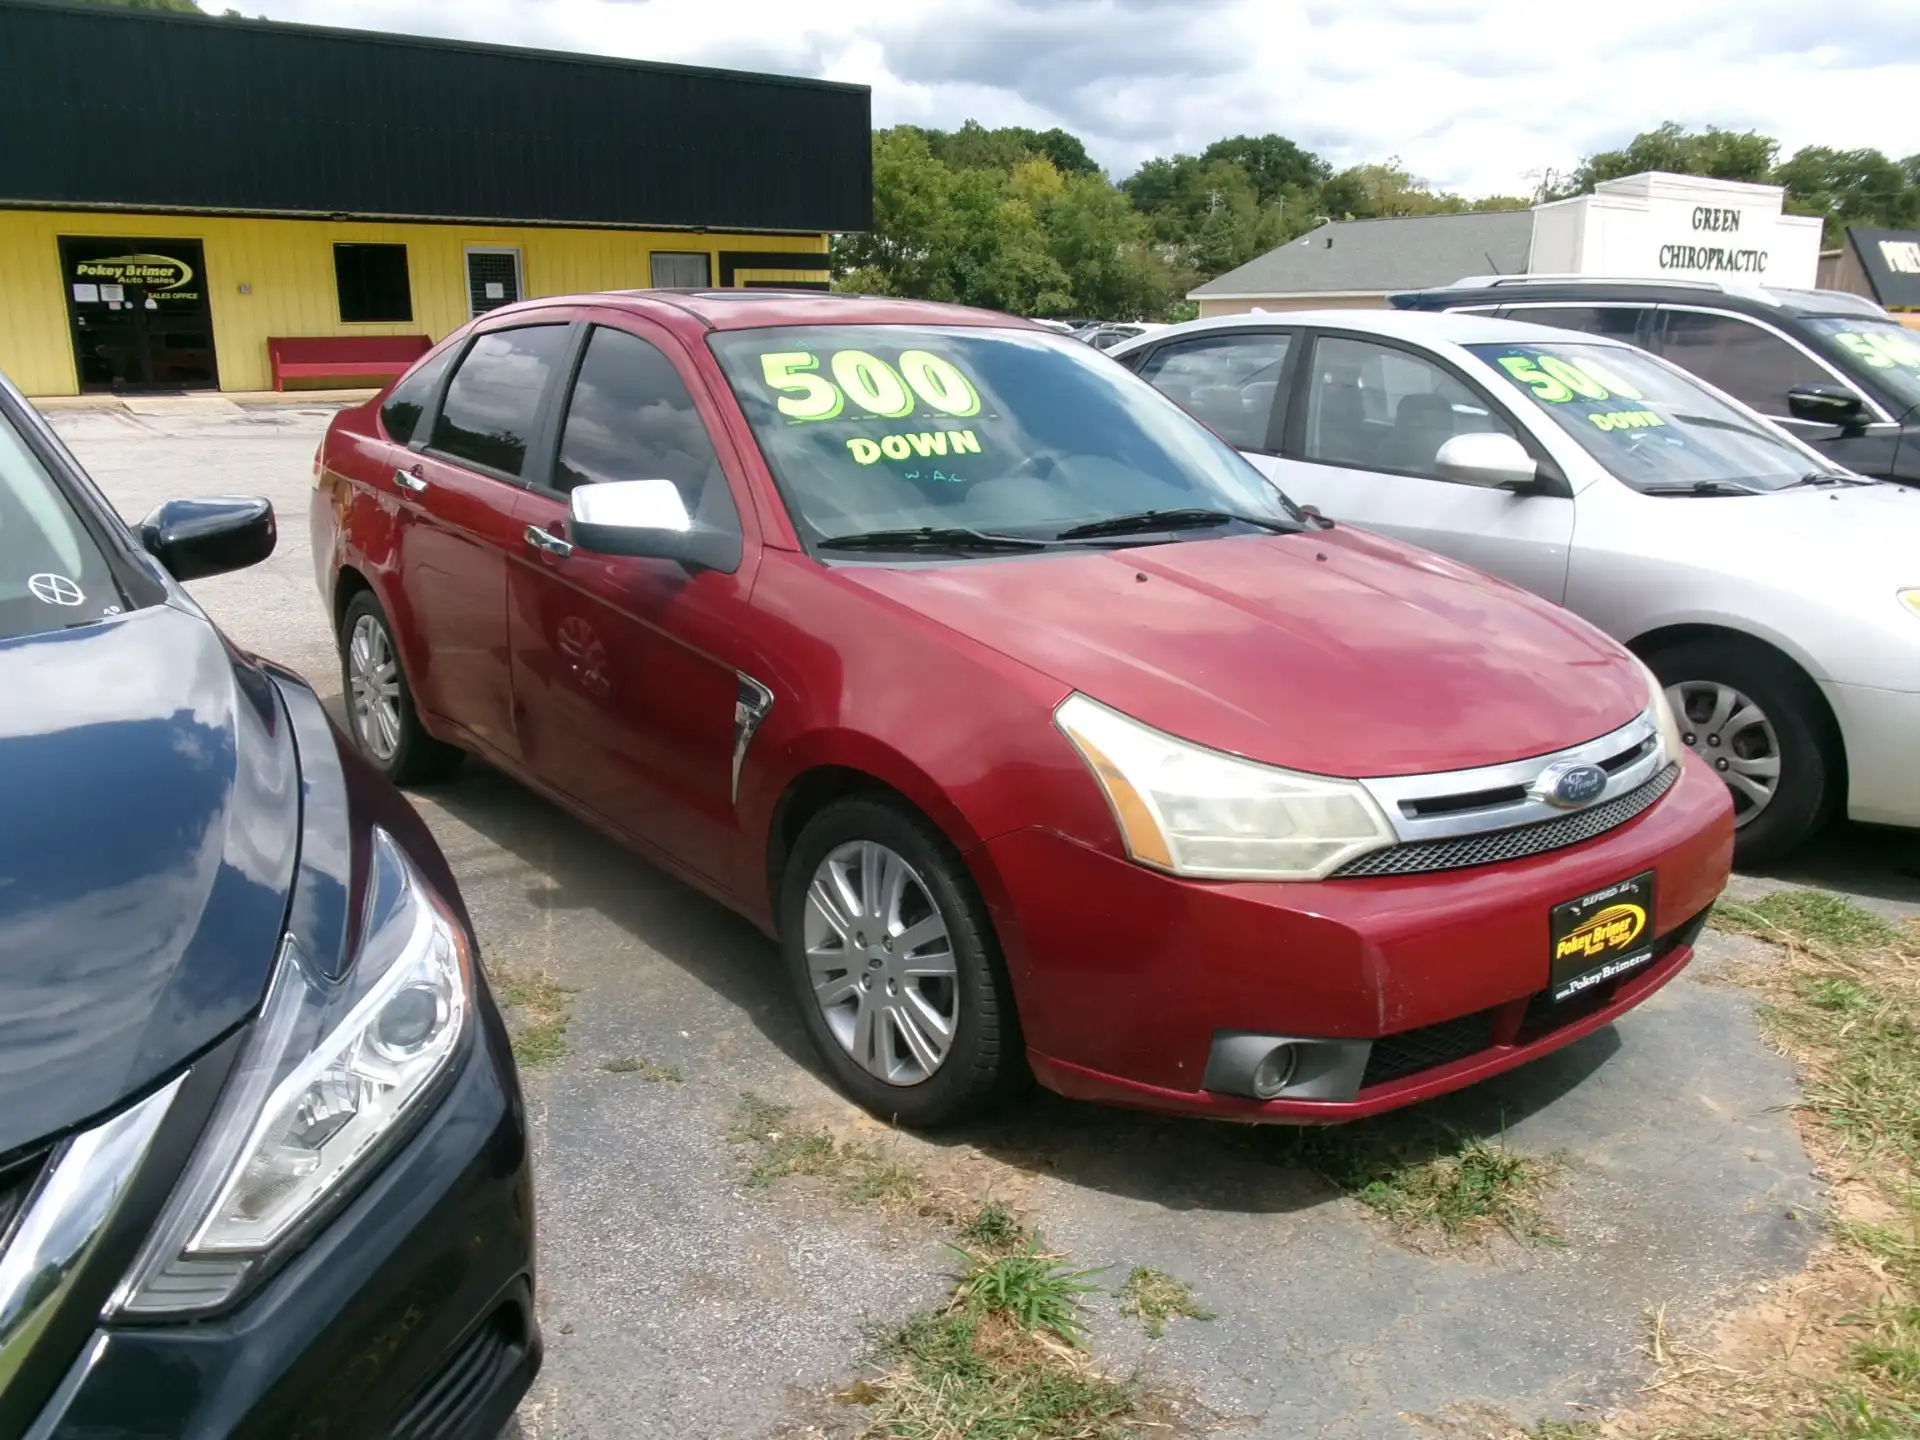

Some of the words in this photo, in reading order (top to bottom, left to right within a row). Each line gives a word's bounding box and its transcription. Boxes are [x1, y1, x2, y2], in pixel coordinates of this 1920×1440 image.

[1692, 206, 1741, 232] GREEN
[77, 264, 124, 279] Pokey
[125, 264, 175, 277] Brimer
[1659, 244, 1768, 272] CHIROPRACTIC
[117, 276, 144, 284] Auto
[146, 276, 176, 284] Sales
[148, 292, 171, 300] SALES
[172, 292, 198, 300] OFFICE
[760, 350, 981, 421] 500
[1497, 356, 1643, 404] 500
[1588, 411, 1666, 432] DOWN
[846, 430, 981, 465] DOWN
[1563, 770, 1599, 798] Ford
[1582, 887, 1619, 907] OXFORD
[1556, 933, 1592, 959] Pokey
[1593, 917, 1632, 941] Brimer
[1583, 942, 1605, 957] Auto
[1609, 930, 1631, 946] Sales
